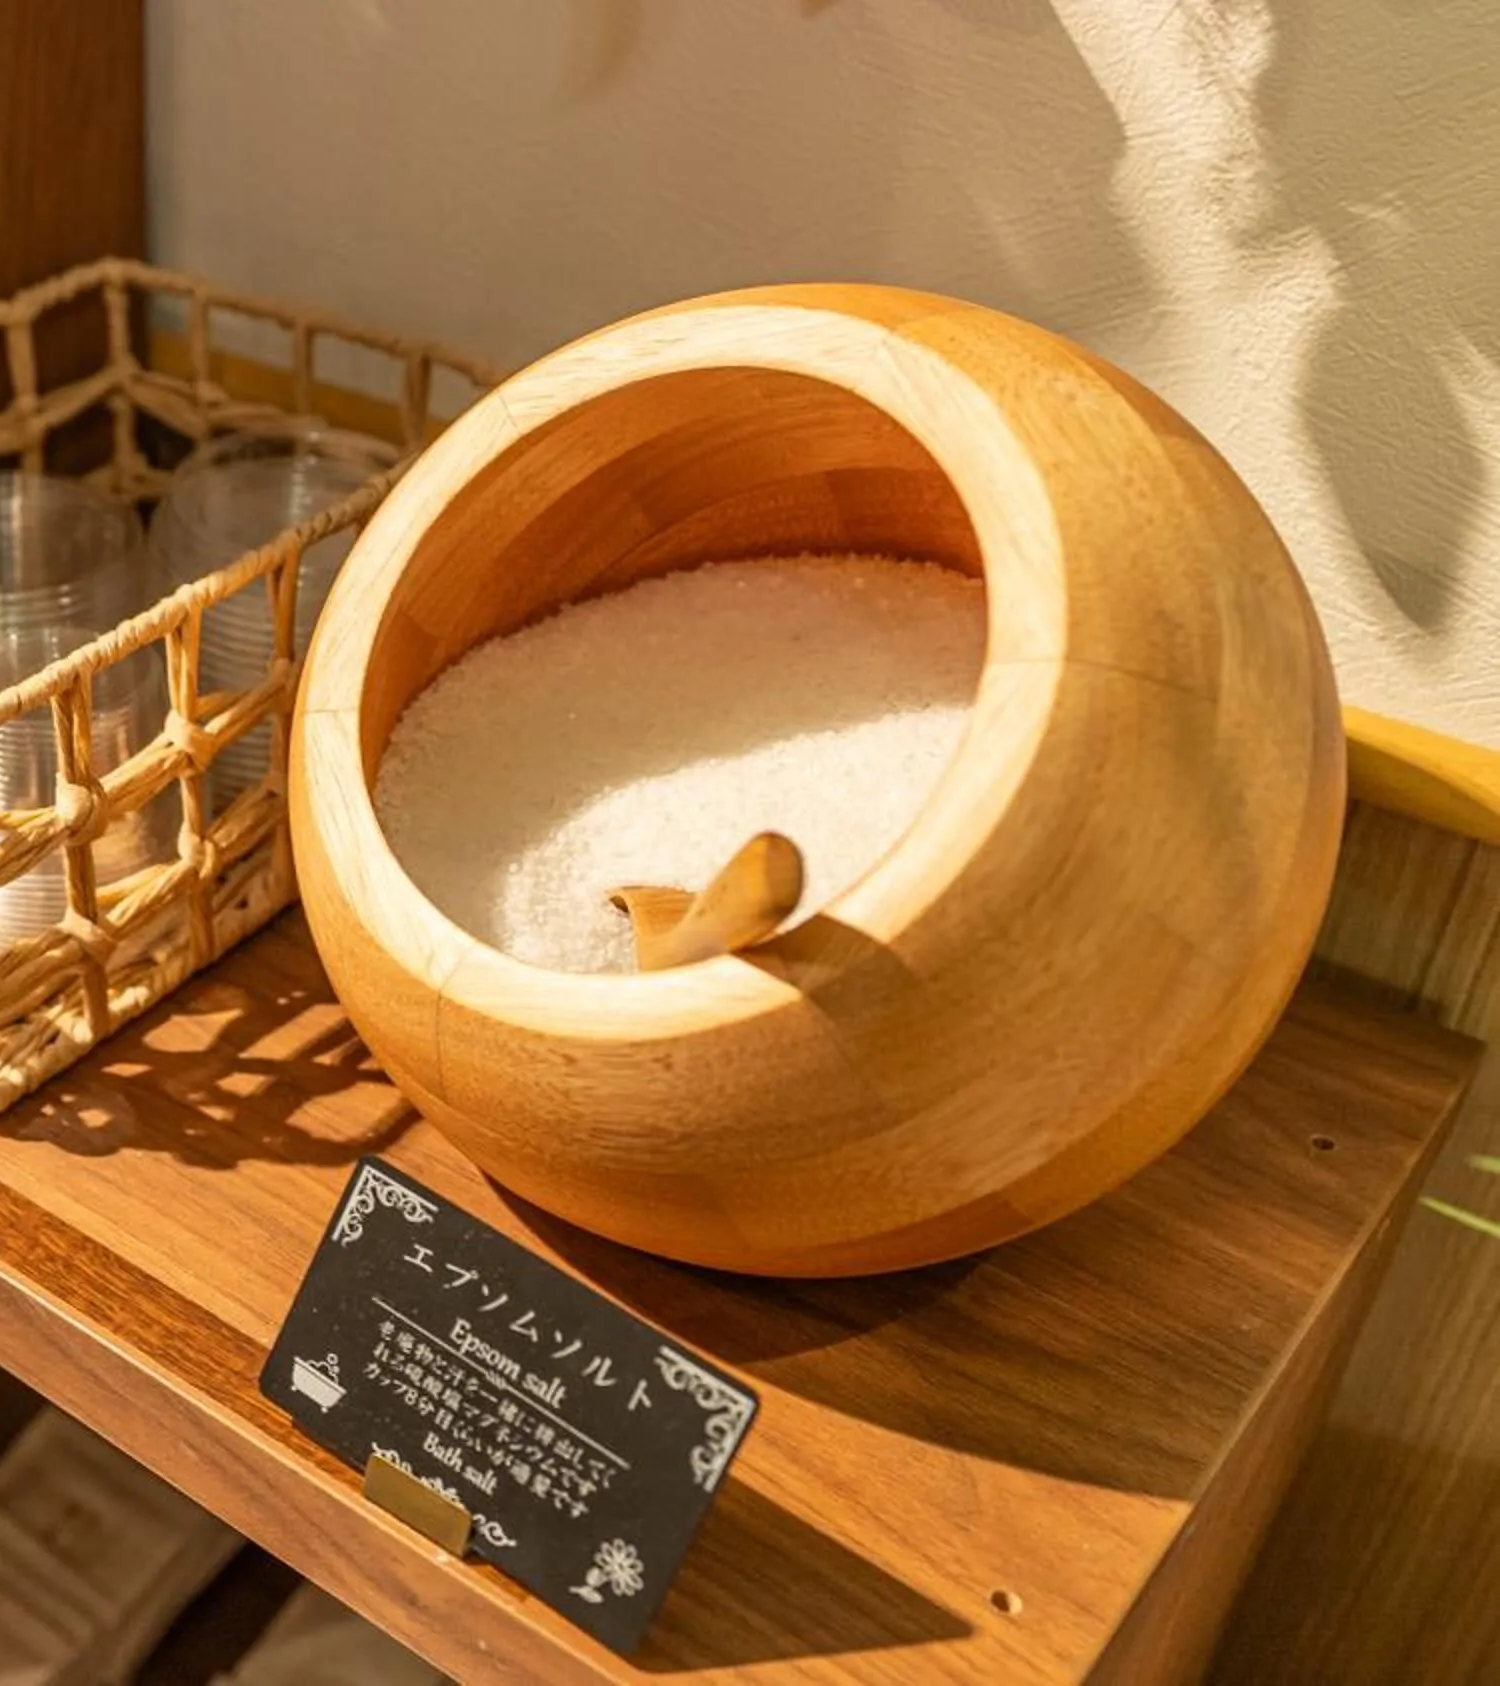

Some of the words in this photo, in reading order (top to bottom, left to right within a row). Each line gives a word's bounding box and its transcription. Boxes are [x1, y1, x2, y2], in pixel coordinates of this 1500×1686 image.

[403, 1243, 652, 1410] エプソムソルト
[449, 1318, 521, 1380] Epsom
[521, 1372, 567, 1409] salt
[422, 1431, 463, 1474] Bath
[462, 1465, 498, 1496] salt
